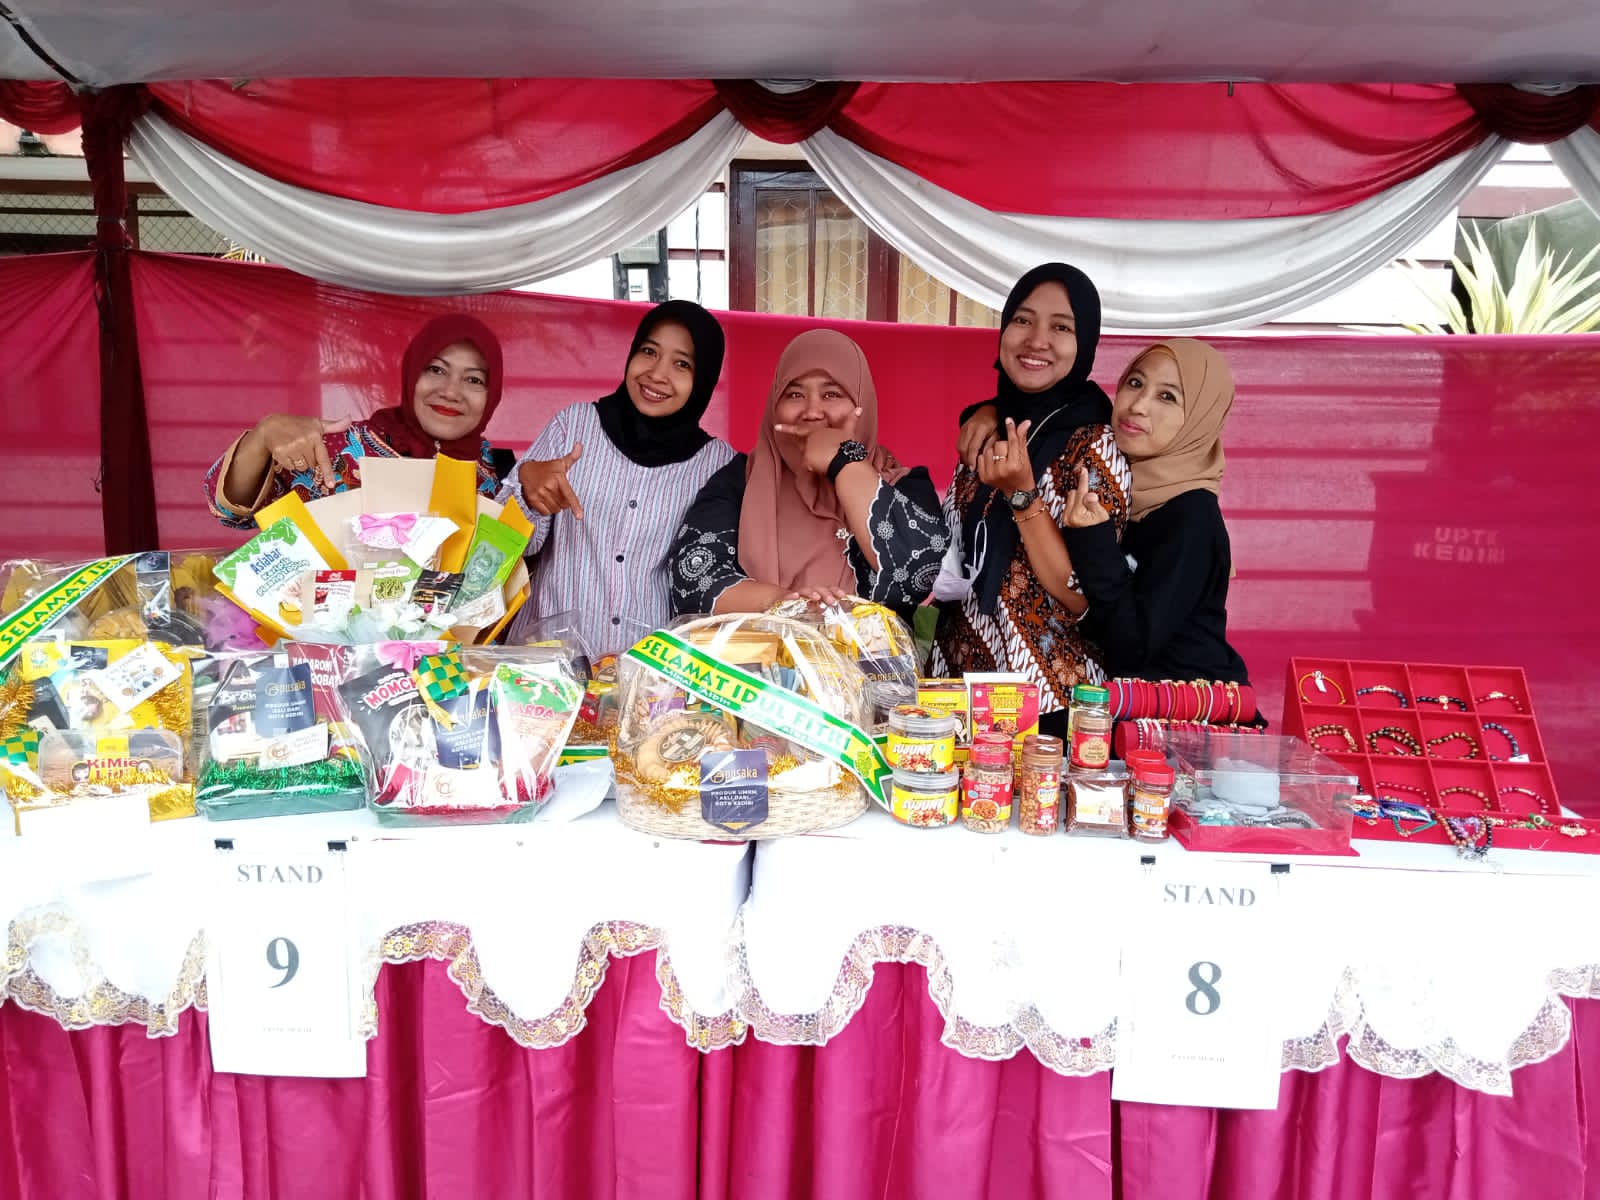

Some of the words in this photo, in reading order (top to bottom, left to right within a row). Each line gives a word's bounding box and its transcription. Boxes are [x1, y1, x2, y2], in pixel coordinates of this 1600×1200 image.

[1, 576, 88, 645] SELAMAT
[641, 638, 730, 691] SELAMAT
[791, 710, 852, 751] FITRI
[87, 757, 138, 769] KiMie
[237, 864, 324, 884] STAND
[1163, 883, 1256, 907] STAND
[266, 936, 300, 989] 9
[1184, 960, 1223, 1016] 8
